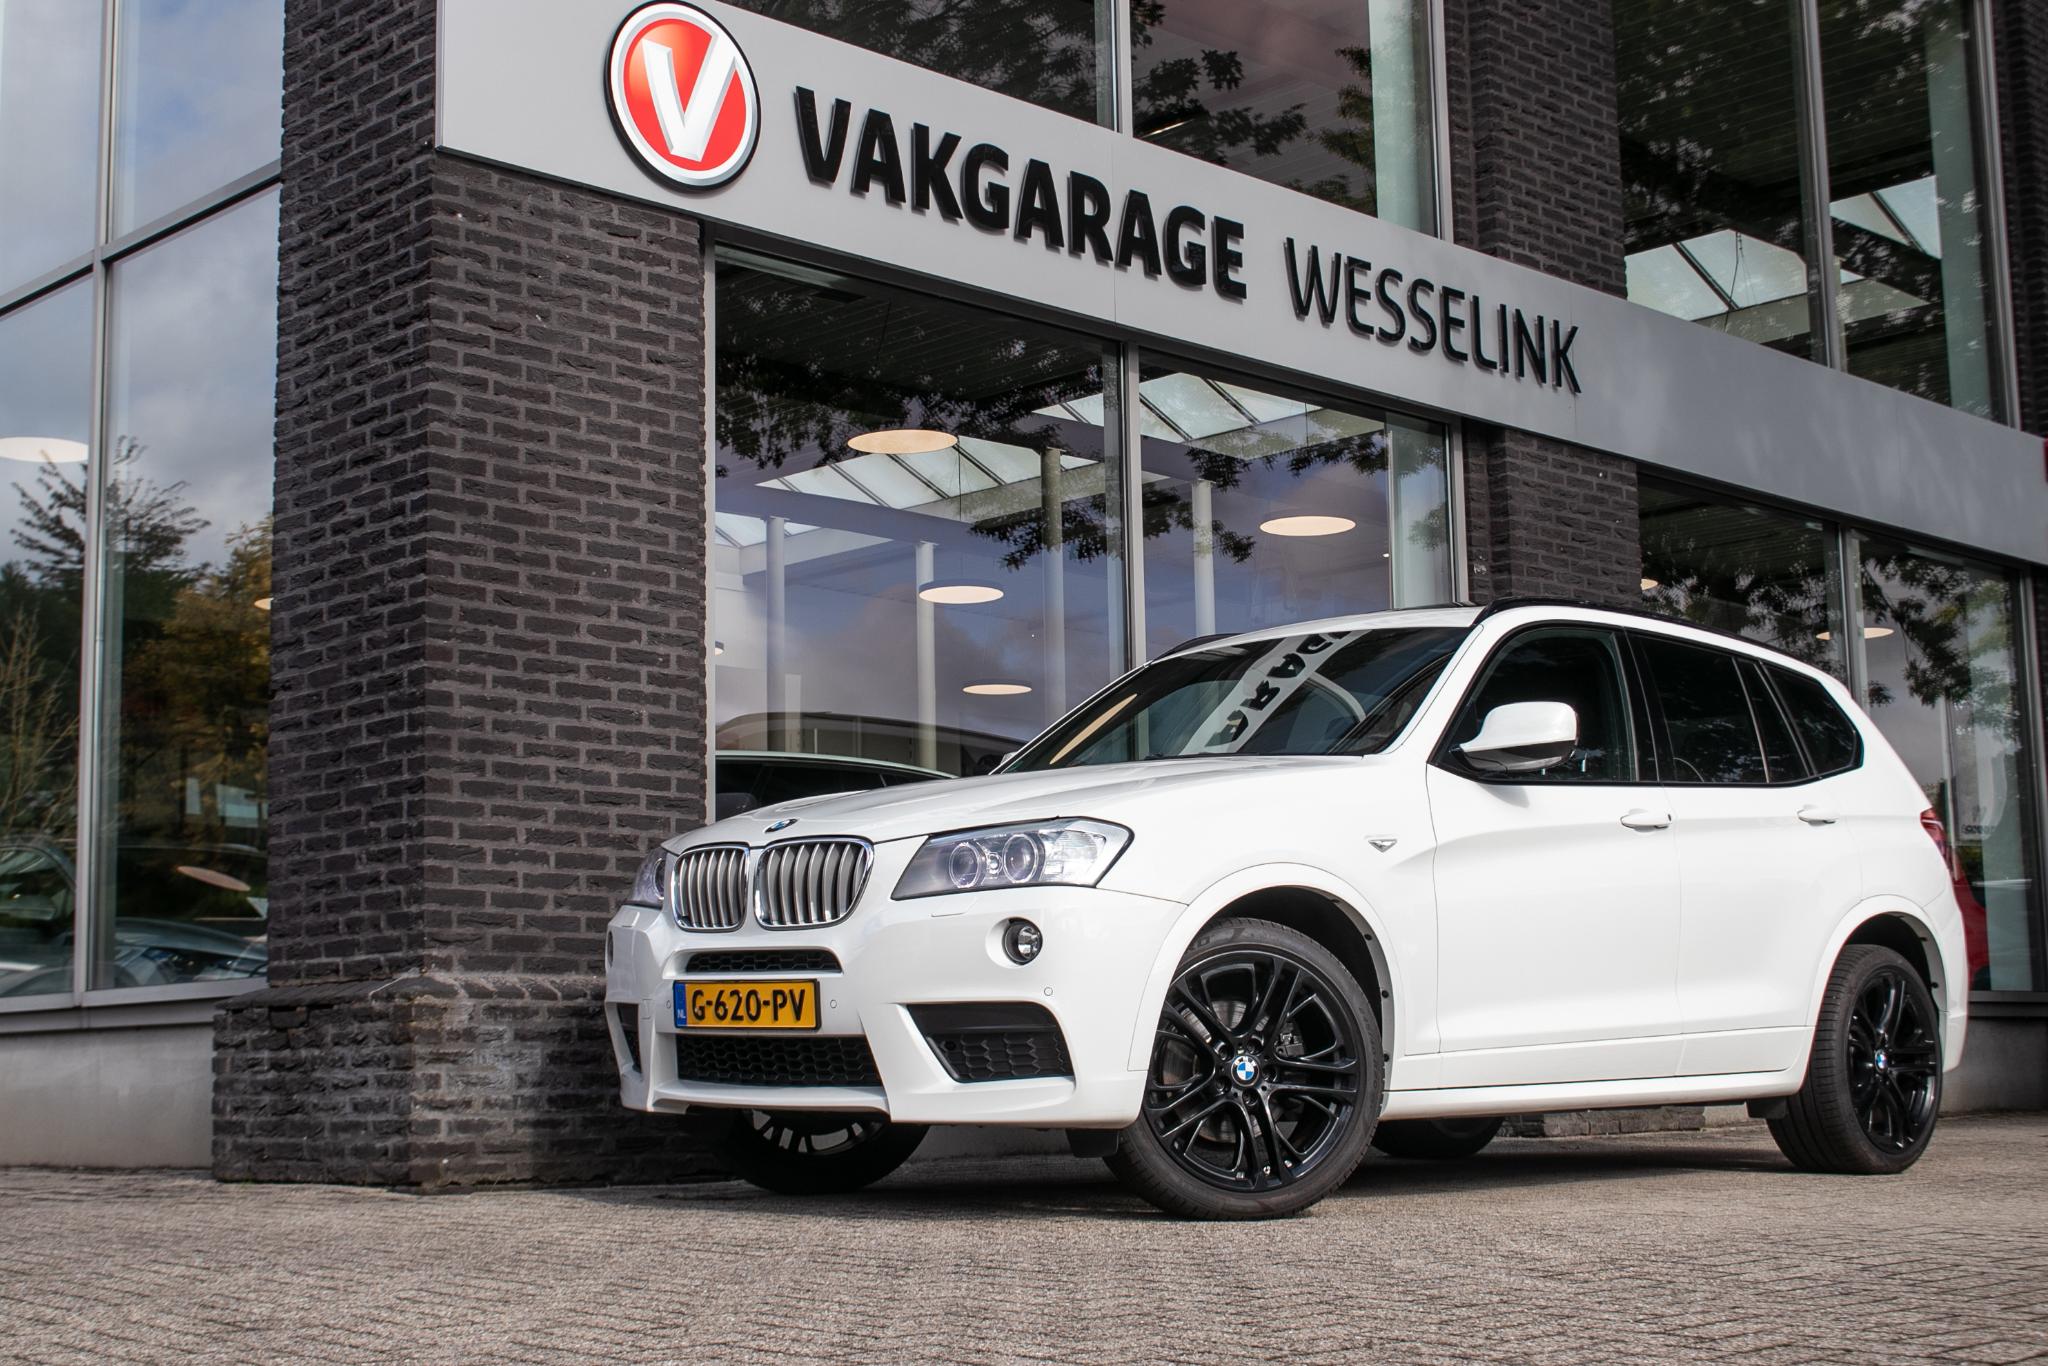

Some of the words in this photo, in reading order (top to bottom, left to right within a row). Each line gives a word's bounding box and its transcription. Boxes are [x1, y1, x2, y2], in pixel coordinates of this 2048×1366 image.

[641, 32, 738, 163] V
[795, 85, 1247, 301] VAKGARAGE
[1285, 237, 1581, 394] WESSELINK
[677, 1009, 686, 1019] NL
[692, 988, 806, 1022] G-620-PV
